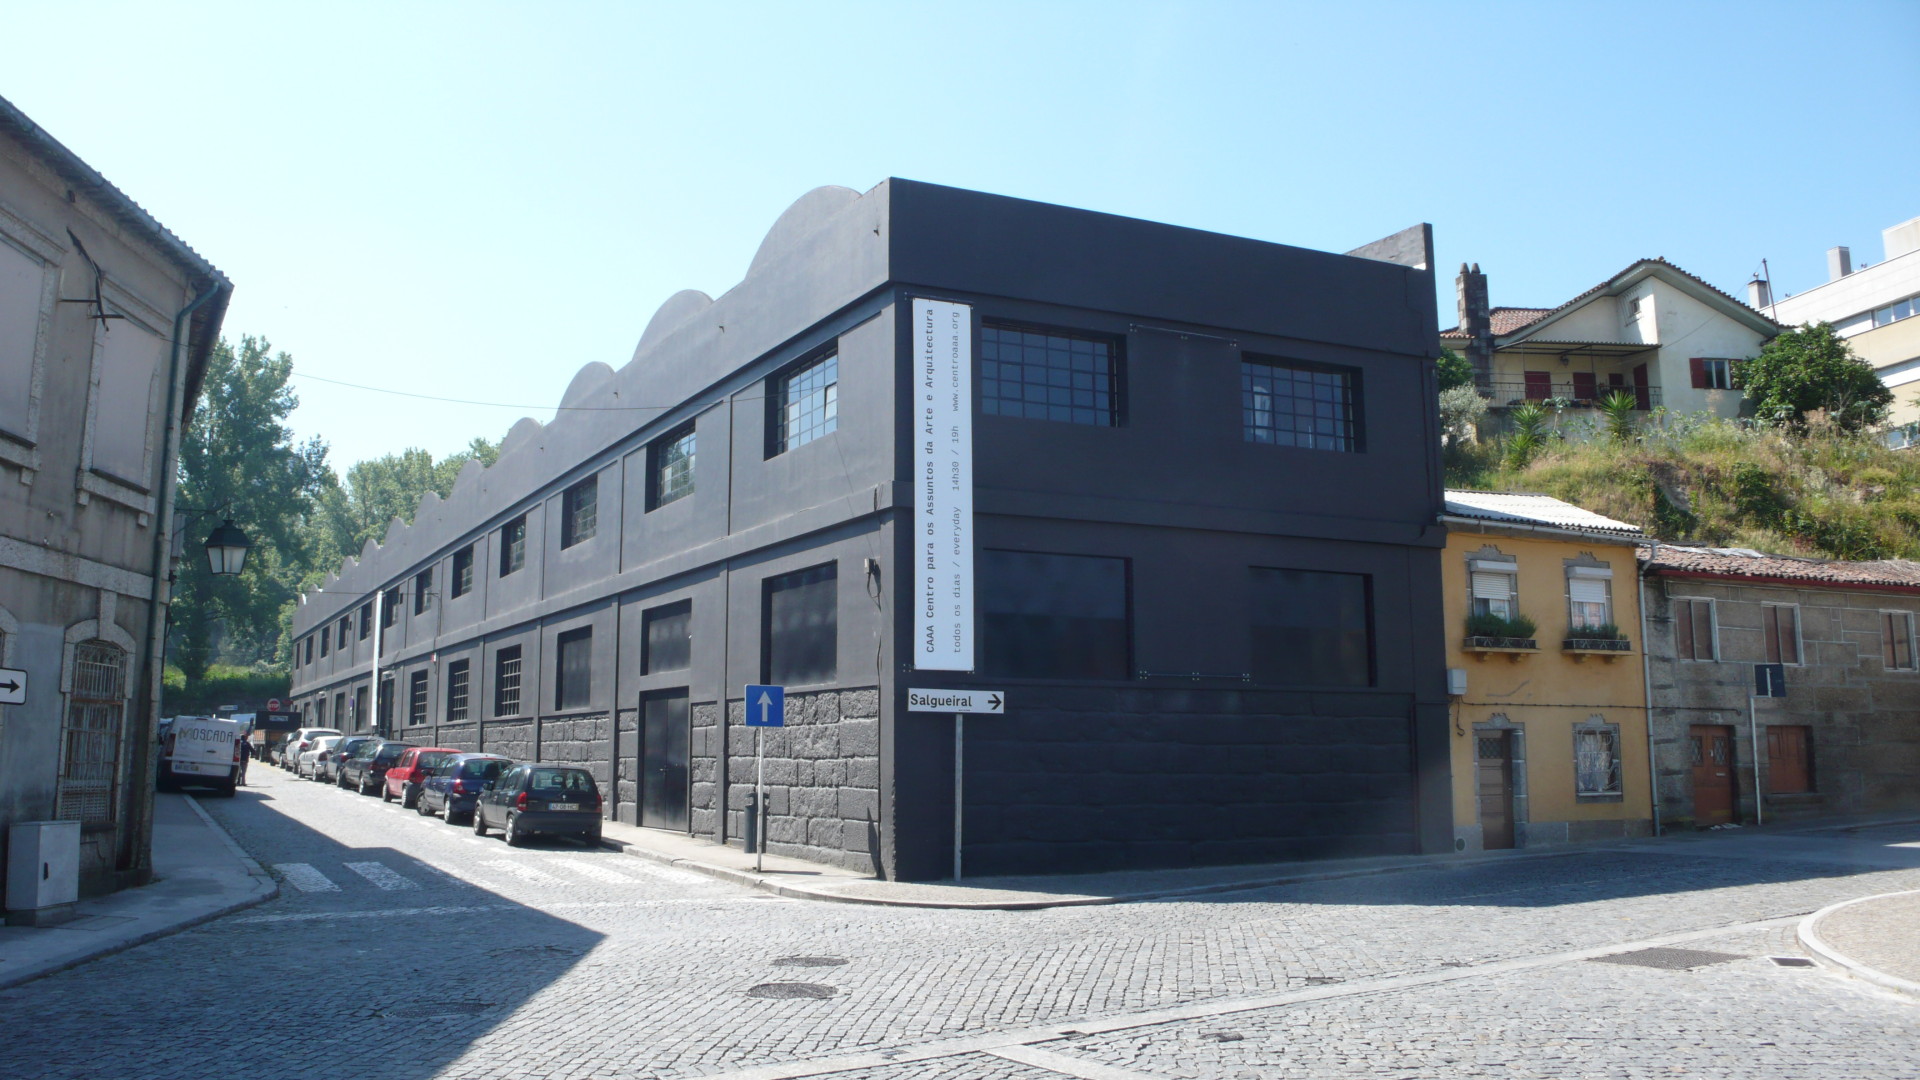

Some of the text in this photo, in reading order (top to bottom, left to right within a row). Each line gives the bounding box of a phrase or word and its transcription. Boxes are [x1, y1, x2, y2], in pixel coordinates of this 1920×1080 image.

[924, 308, 935, 388] Arquitectura
[951, 311, 961, 412] www.centroaaa.org
[924, 407, 934, 435] Arte
[951, 425, 960, 444] 19h
[924, 441, 934, 455] da
[925, 461, 935, 516] Assuntos
[951, 461, 960, 492] 14h30
[925, 522, 935, 536] os
[952, 506, 962, 555] everyday
[925, 543, 936, 570] para
[925, 577, 935, 618] Centro
[952, 573, 961, 598] dias
[953, 604, 961, 617] os
[925, 625, 936, 653] CAAA
[952, 623, 961, 653] todos
[910, 693, 972, 708] Salgueiral
[178, 726, 234, 744] MOSCADA
